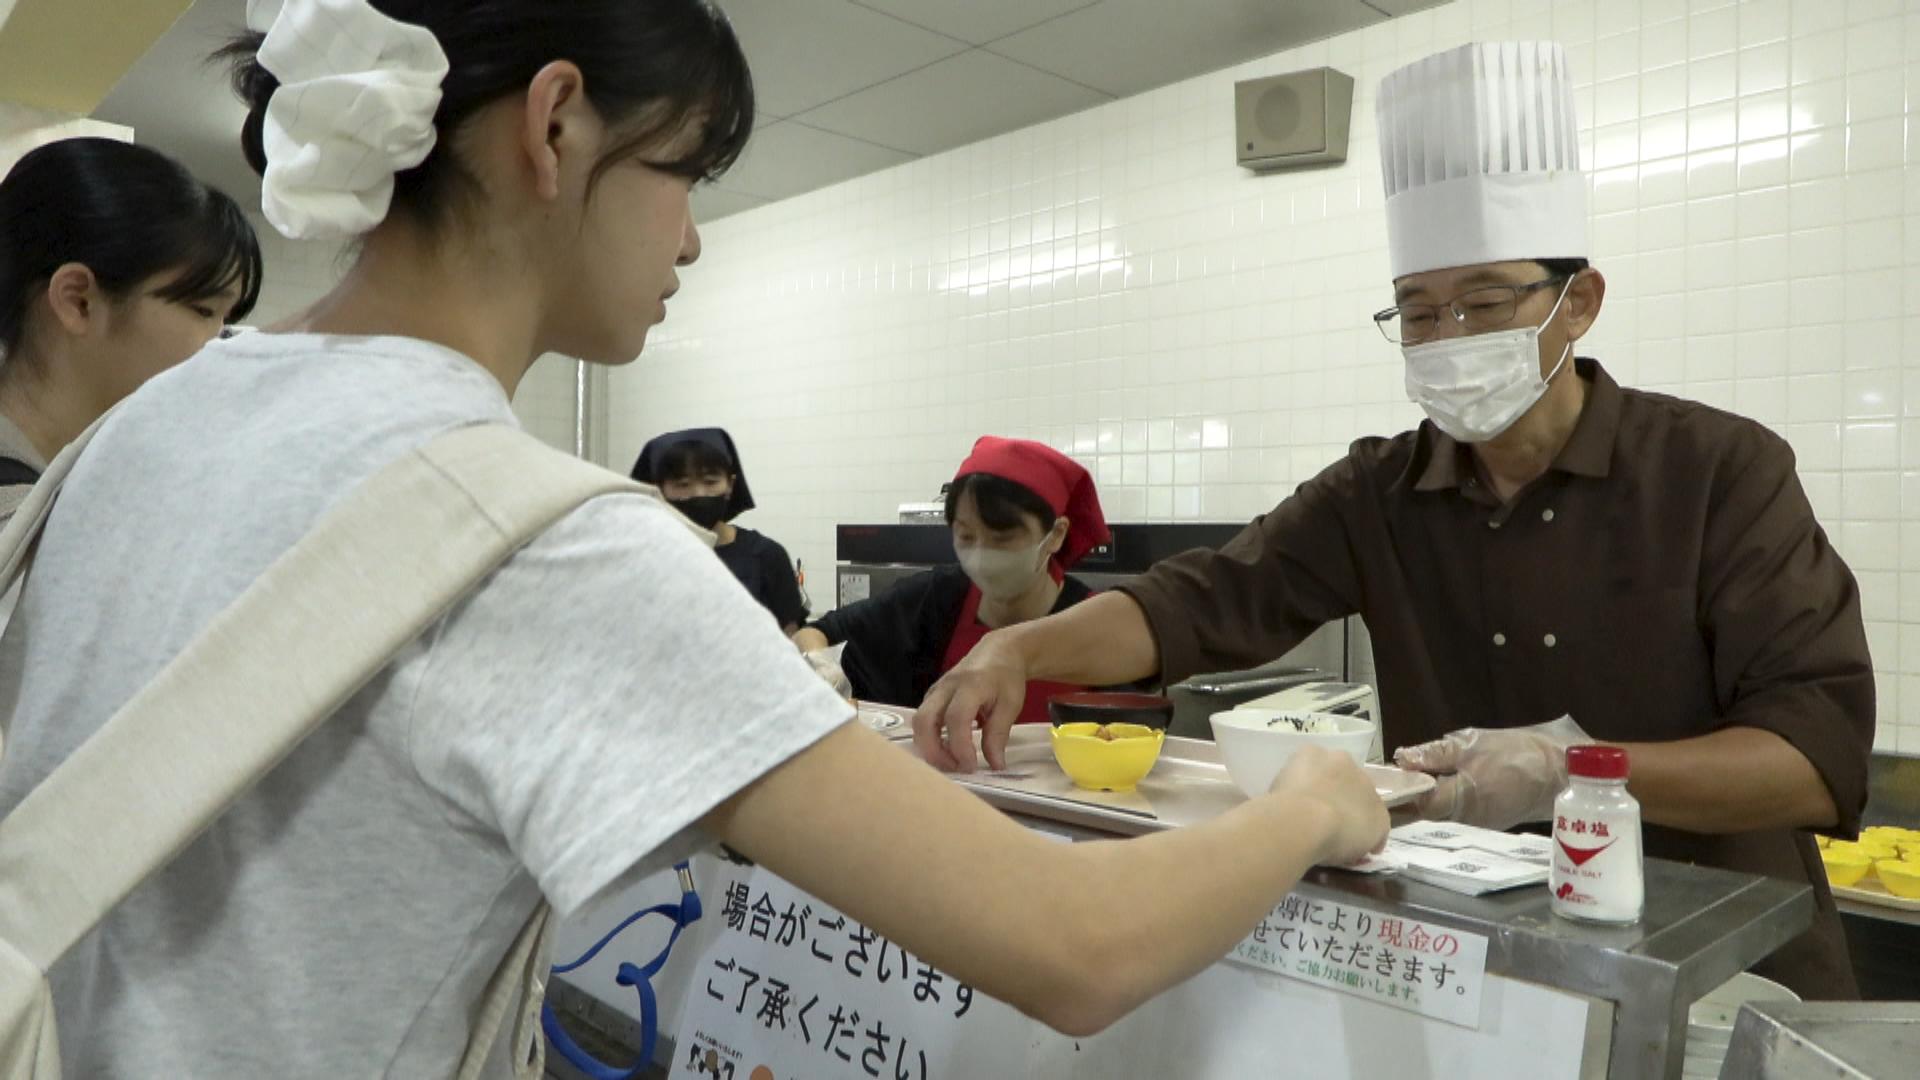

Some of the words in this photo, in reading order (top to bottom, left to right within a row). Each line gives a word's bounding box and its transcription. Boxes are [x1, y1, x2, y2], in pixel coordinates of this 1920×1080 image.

[1270, 896, 1459, 957] 導により現金の
[707, 958, 927, 1080] ご了承ください
